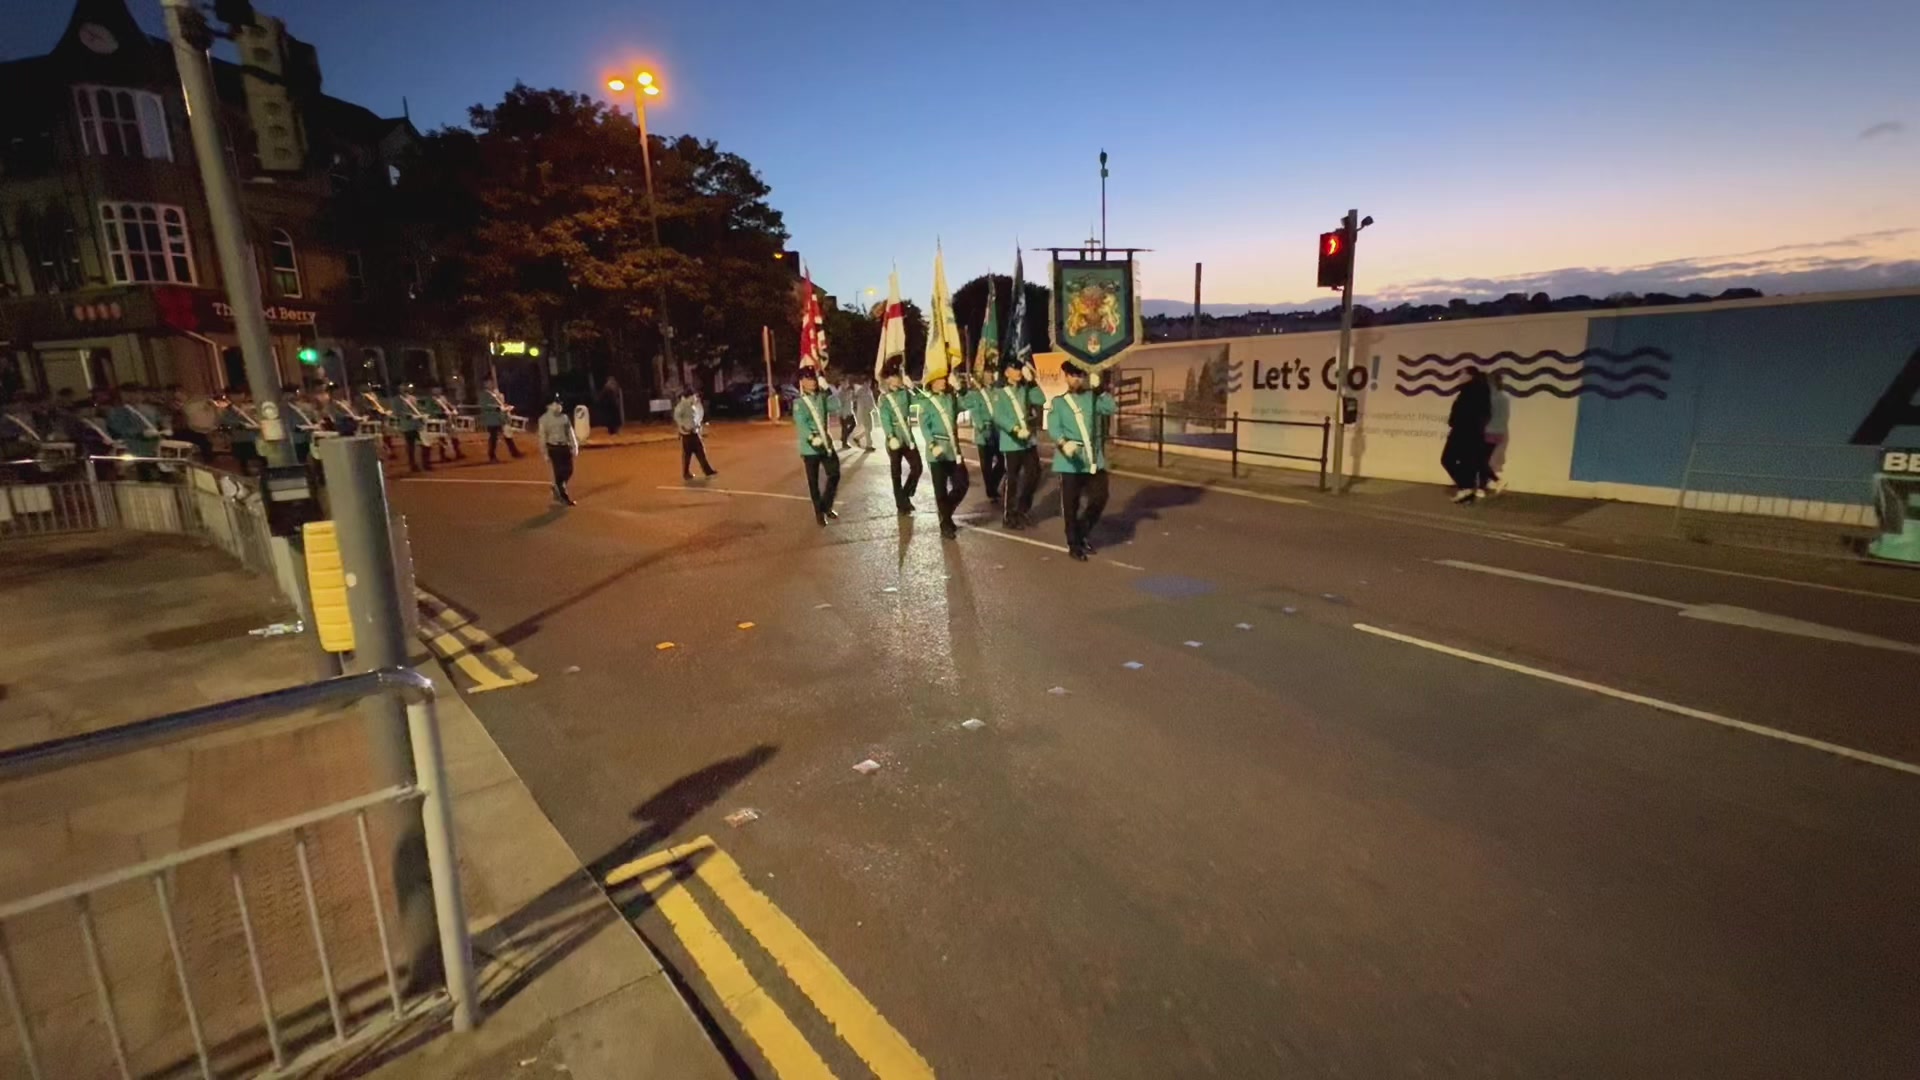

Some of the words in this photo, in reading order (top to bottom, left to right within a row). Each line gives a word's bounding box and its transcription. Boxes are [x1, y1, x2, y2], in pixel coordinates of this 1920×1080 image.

[278, 306, 316, 322] Berry
[1253, 358, 1310, 390] Let's
[1322, 355, 1380, 391] Go!
